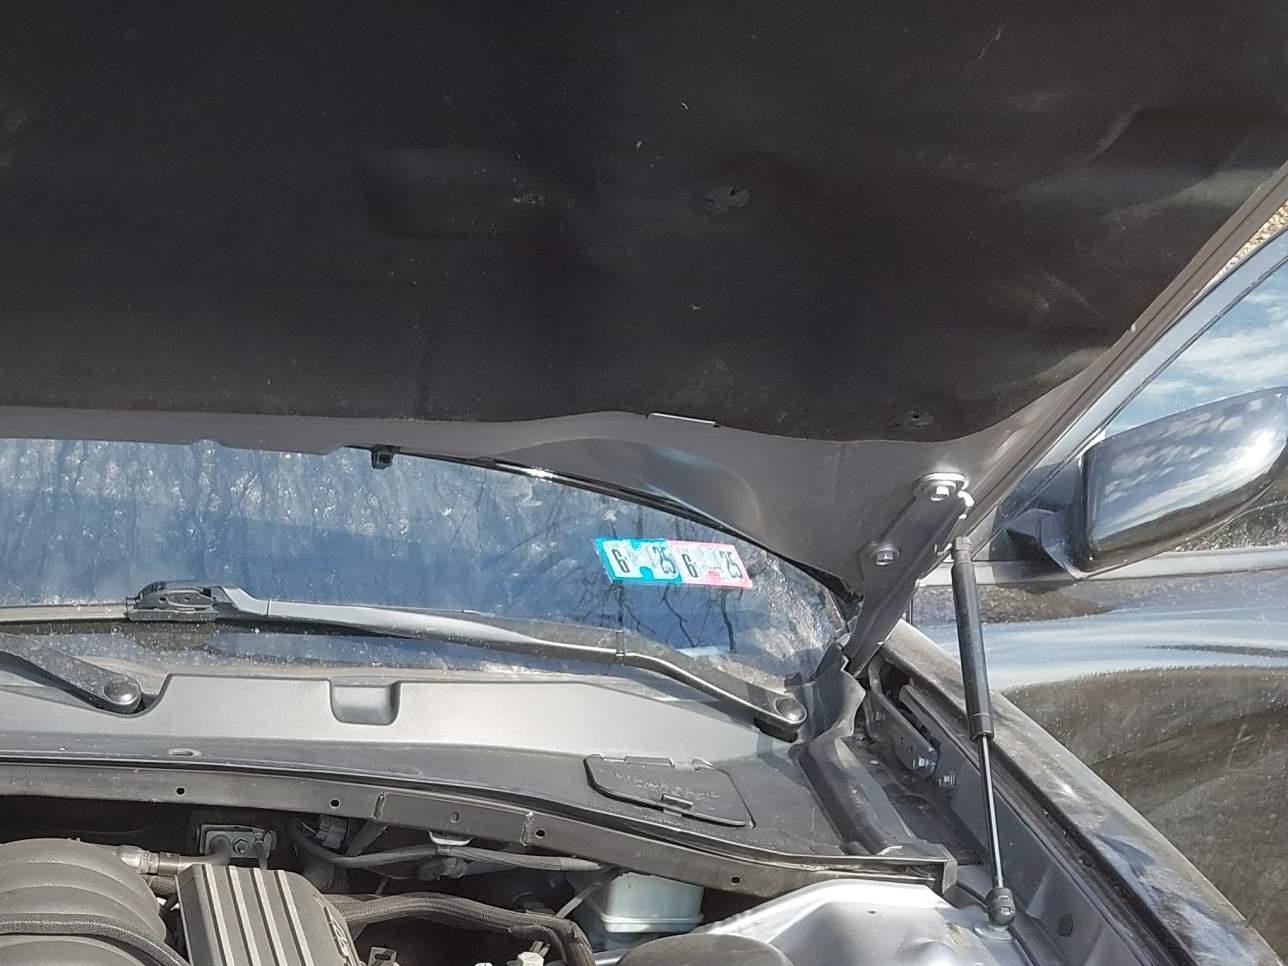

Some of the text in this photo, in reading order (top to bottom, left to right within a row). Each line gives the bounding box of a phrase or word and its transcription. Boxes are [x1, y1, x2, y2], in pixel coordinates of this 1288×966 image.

[611, 546, 677, 574] 6 25
[681, 550, 743, 579] 6 25
